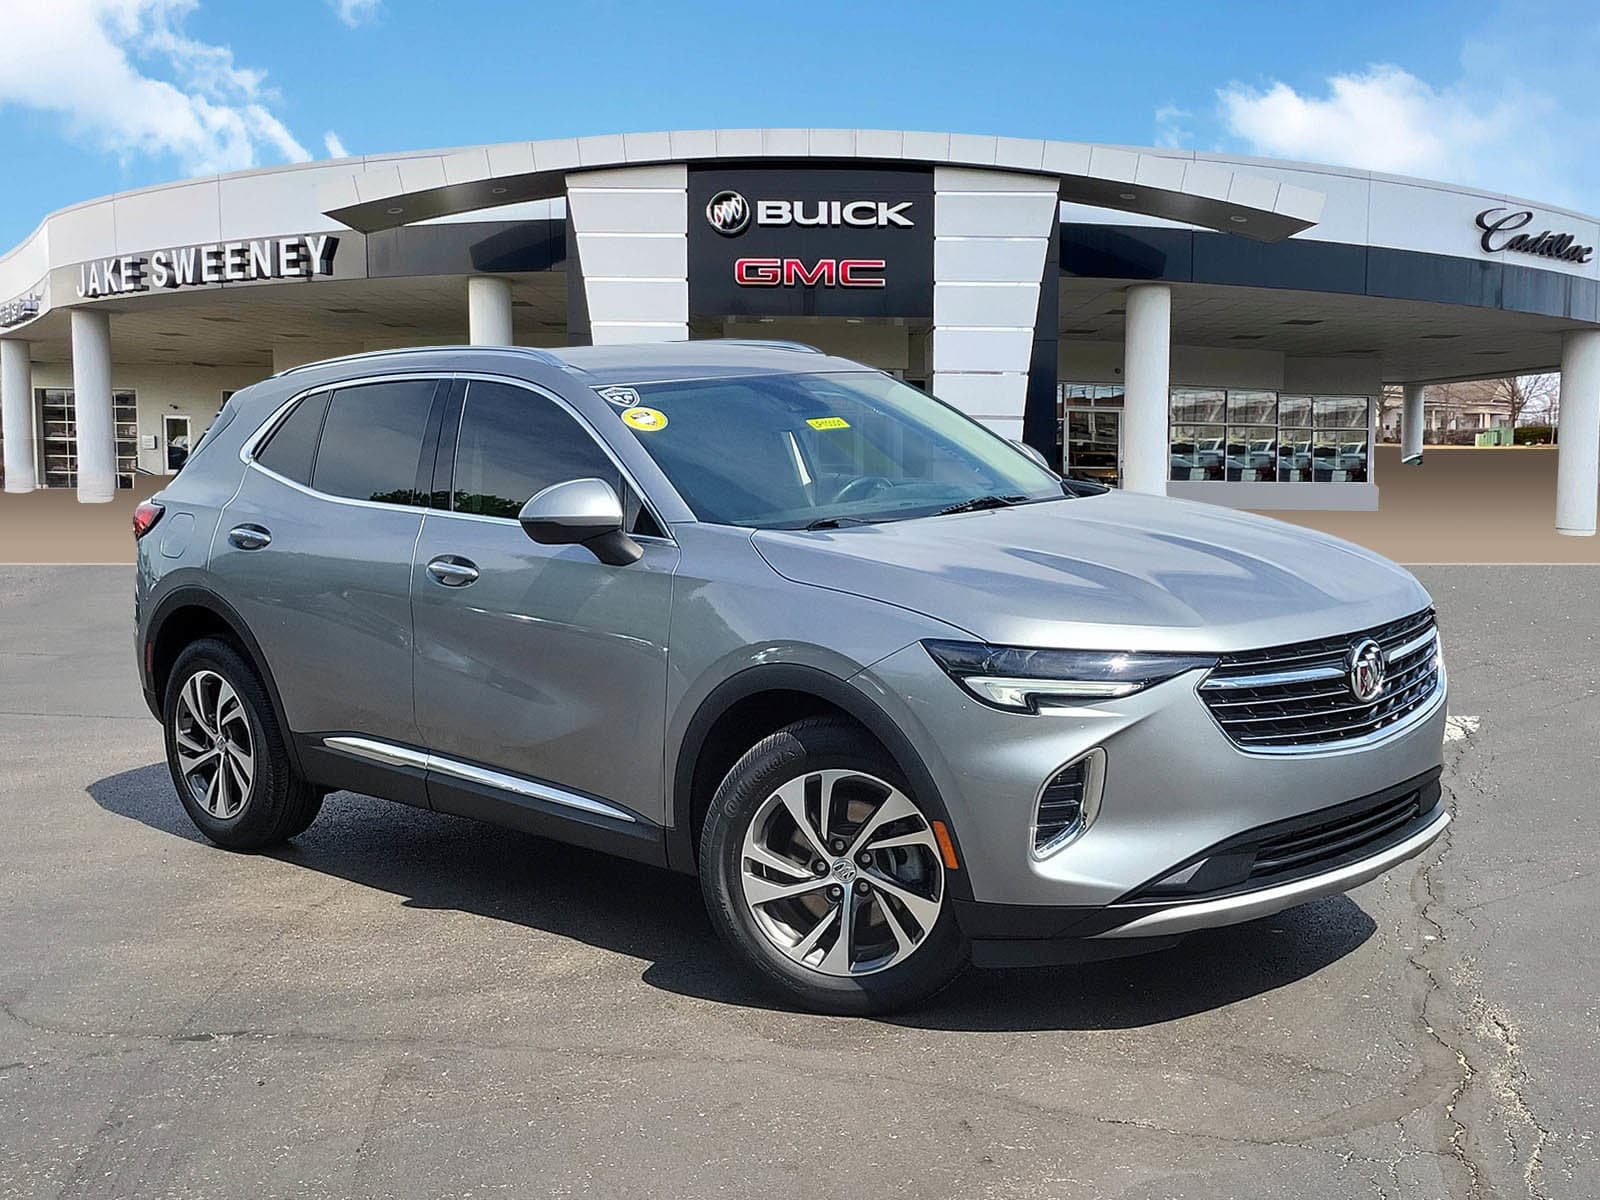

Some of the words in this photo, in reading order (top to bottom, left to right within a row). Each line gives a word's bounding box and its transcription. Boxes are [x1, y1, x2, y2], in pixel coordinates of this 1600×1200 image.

[756, 199, 915, 227] BUICK
[1475, 207, 1594, 264] Cadillac
[76, 256, 138, 298] JAKE
[151, 234, 332, 289] SWEENEY
[734, 257, 887, 287] GMC
